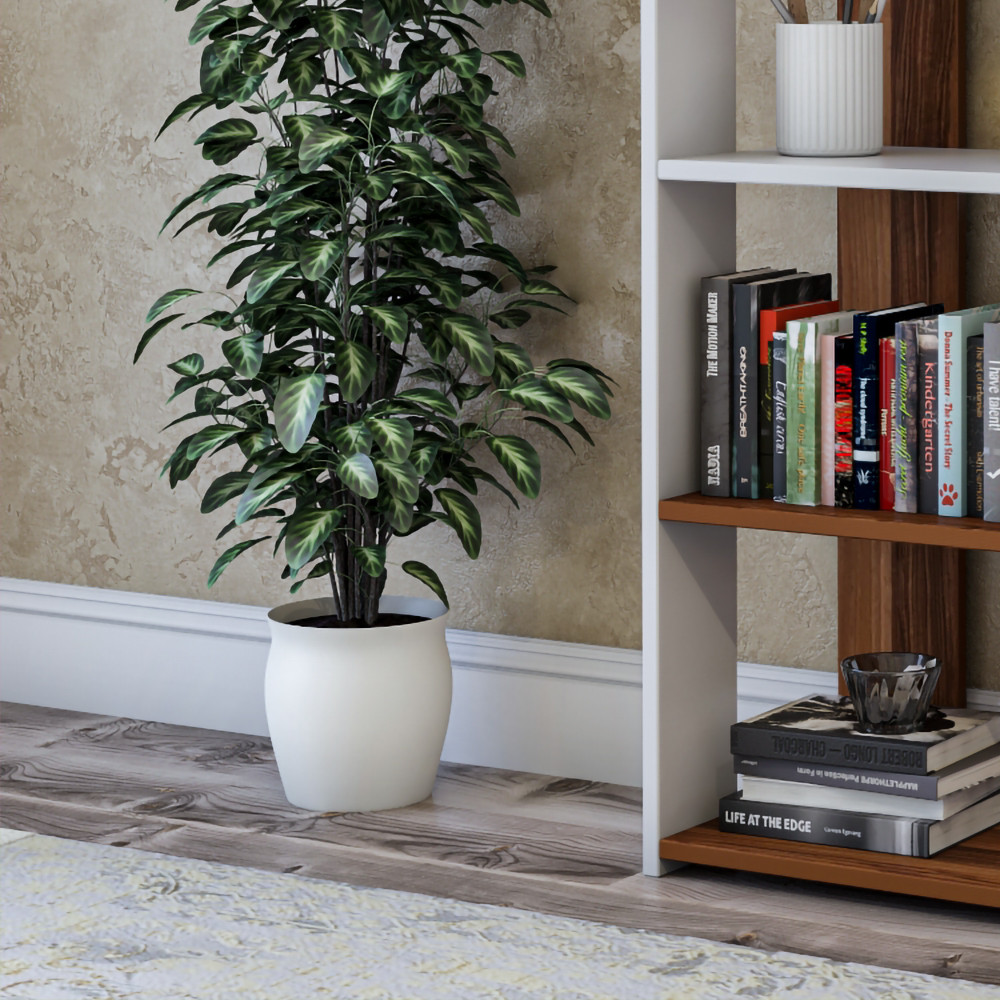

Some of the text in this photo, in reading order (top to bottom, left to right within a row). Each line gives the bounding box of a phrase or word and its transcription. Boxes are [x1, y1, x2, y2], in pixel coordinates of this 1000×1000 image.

[706, 292, 718, 377] THE MOTION MAKER
[944, 331, 953, 359] Donna
[897, 339, 907, 361] rest
[944, 361, 952, 396] Summer
[739, 346, 747, 438] BREATHTAKING
[858, 409, 867, 439] syndrome
[920, 362, 936, 472] Kindergarten
[944, 403, 952, 419] The
[896, 424, 912, 462] Yacht
[944, 420, 953, 445] Secret
[707, 445, 720, 486] NADIA
[943, 448, 952, 470] Story
[896, 465, 907, 499] Secret
[771, 736, 826, 757] CHARCOAL
[844, 744, 878, 763] LONGO
[880, 748, 923, 769] ROBERT
[796, 767, 918, 791] MAPPLETHORPE Perfection in Form
[725, 811, 811, 832] LIFE AT THE EDGE
